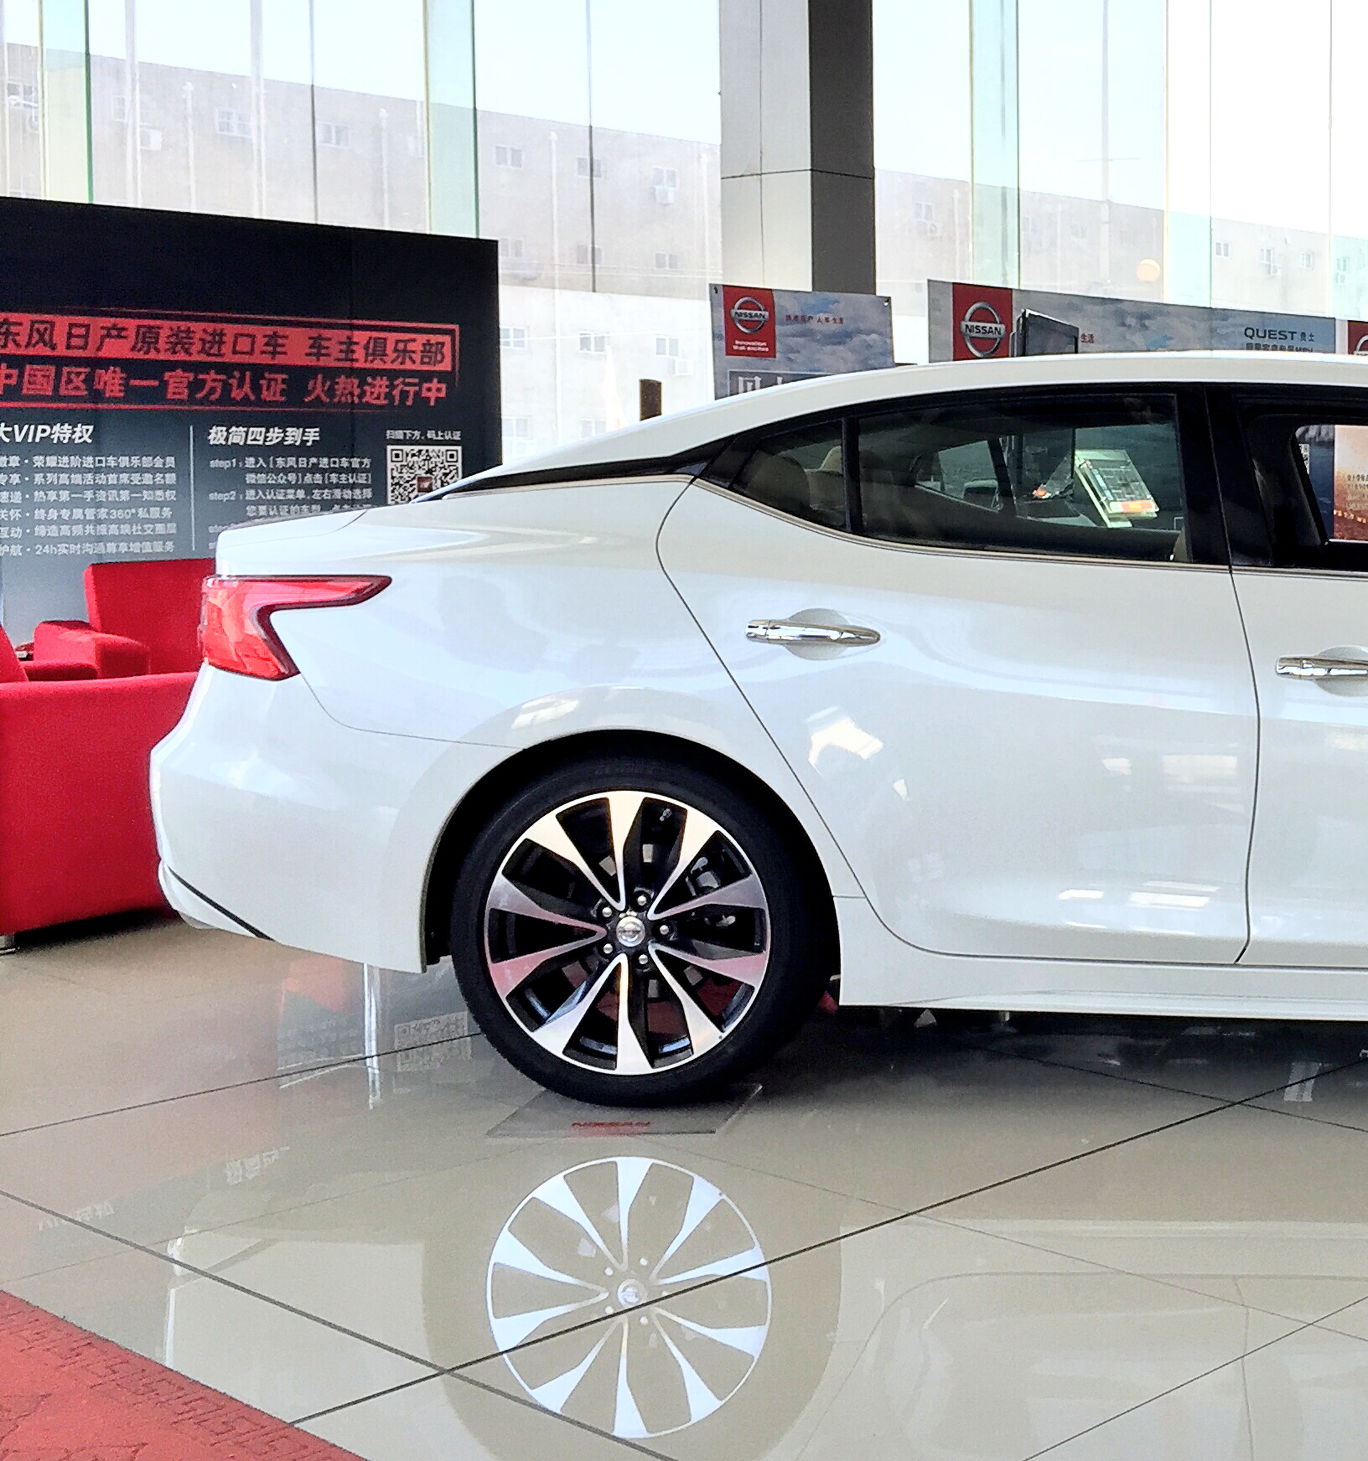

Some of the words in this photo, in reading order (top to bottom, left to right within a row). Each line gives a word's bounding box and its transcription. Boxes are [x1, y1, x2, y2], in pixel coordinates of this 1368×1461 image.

[734, 311, 767, 320] NISSAN
[964, 323, 1002, 336] NISSAN
[1244, 327, 1297, 341] QUEST
[0, 317, 288, 361] 东风日产原装进口车
[305, 334, 446, 367] 车主俱乐部
[0, 362, 289, 402] 中国区唯一官方认证
[304, 373, 448, 407] 火热进行中
[207, 424, 321, 446] 极简四步到手
